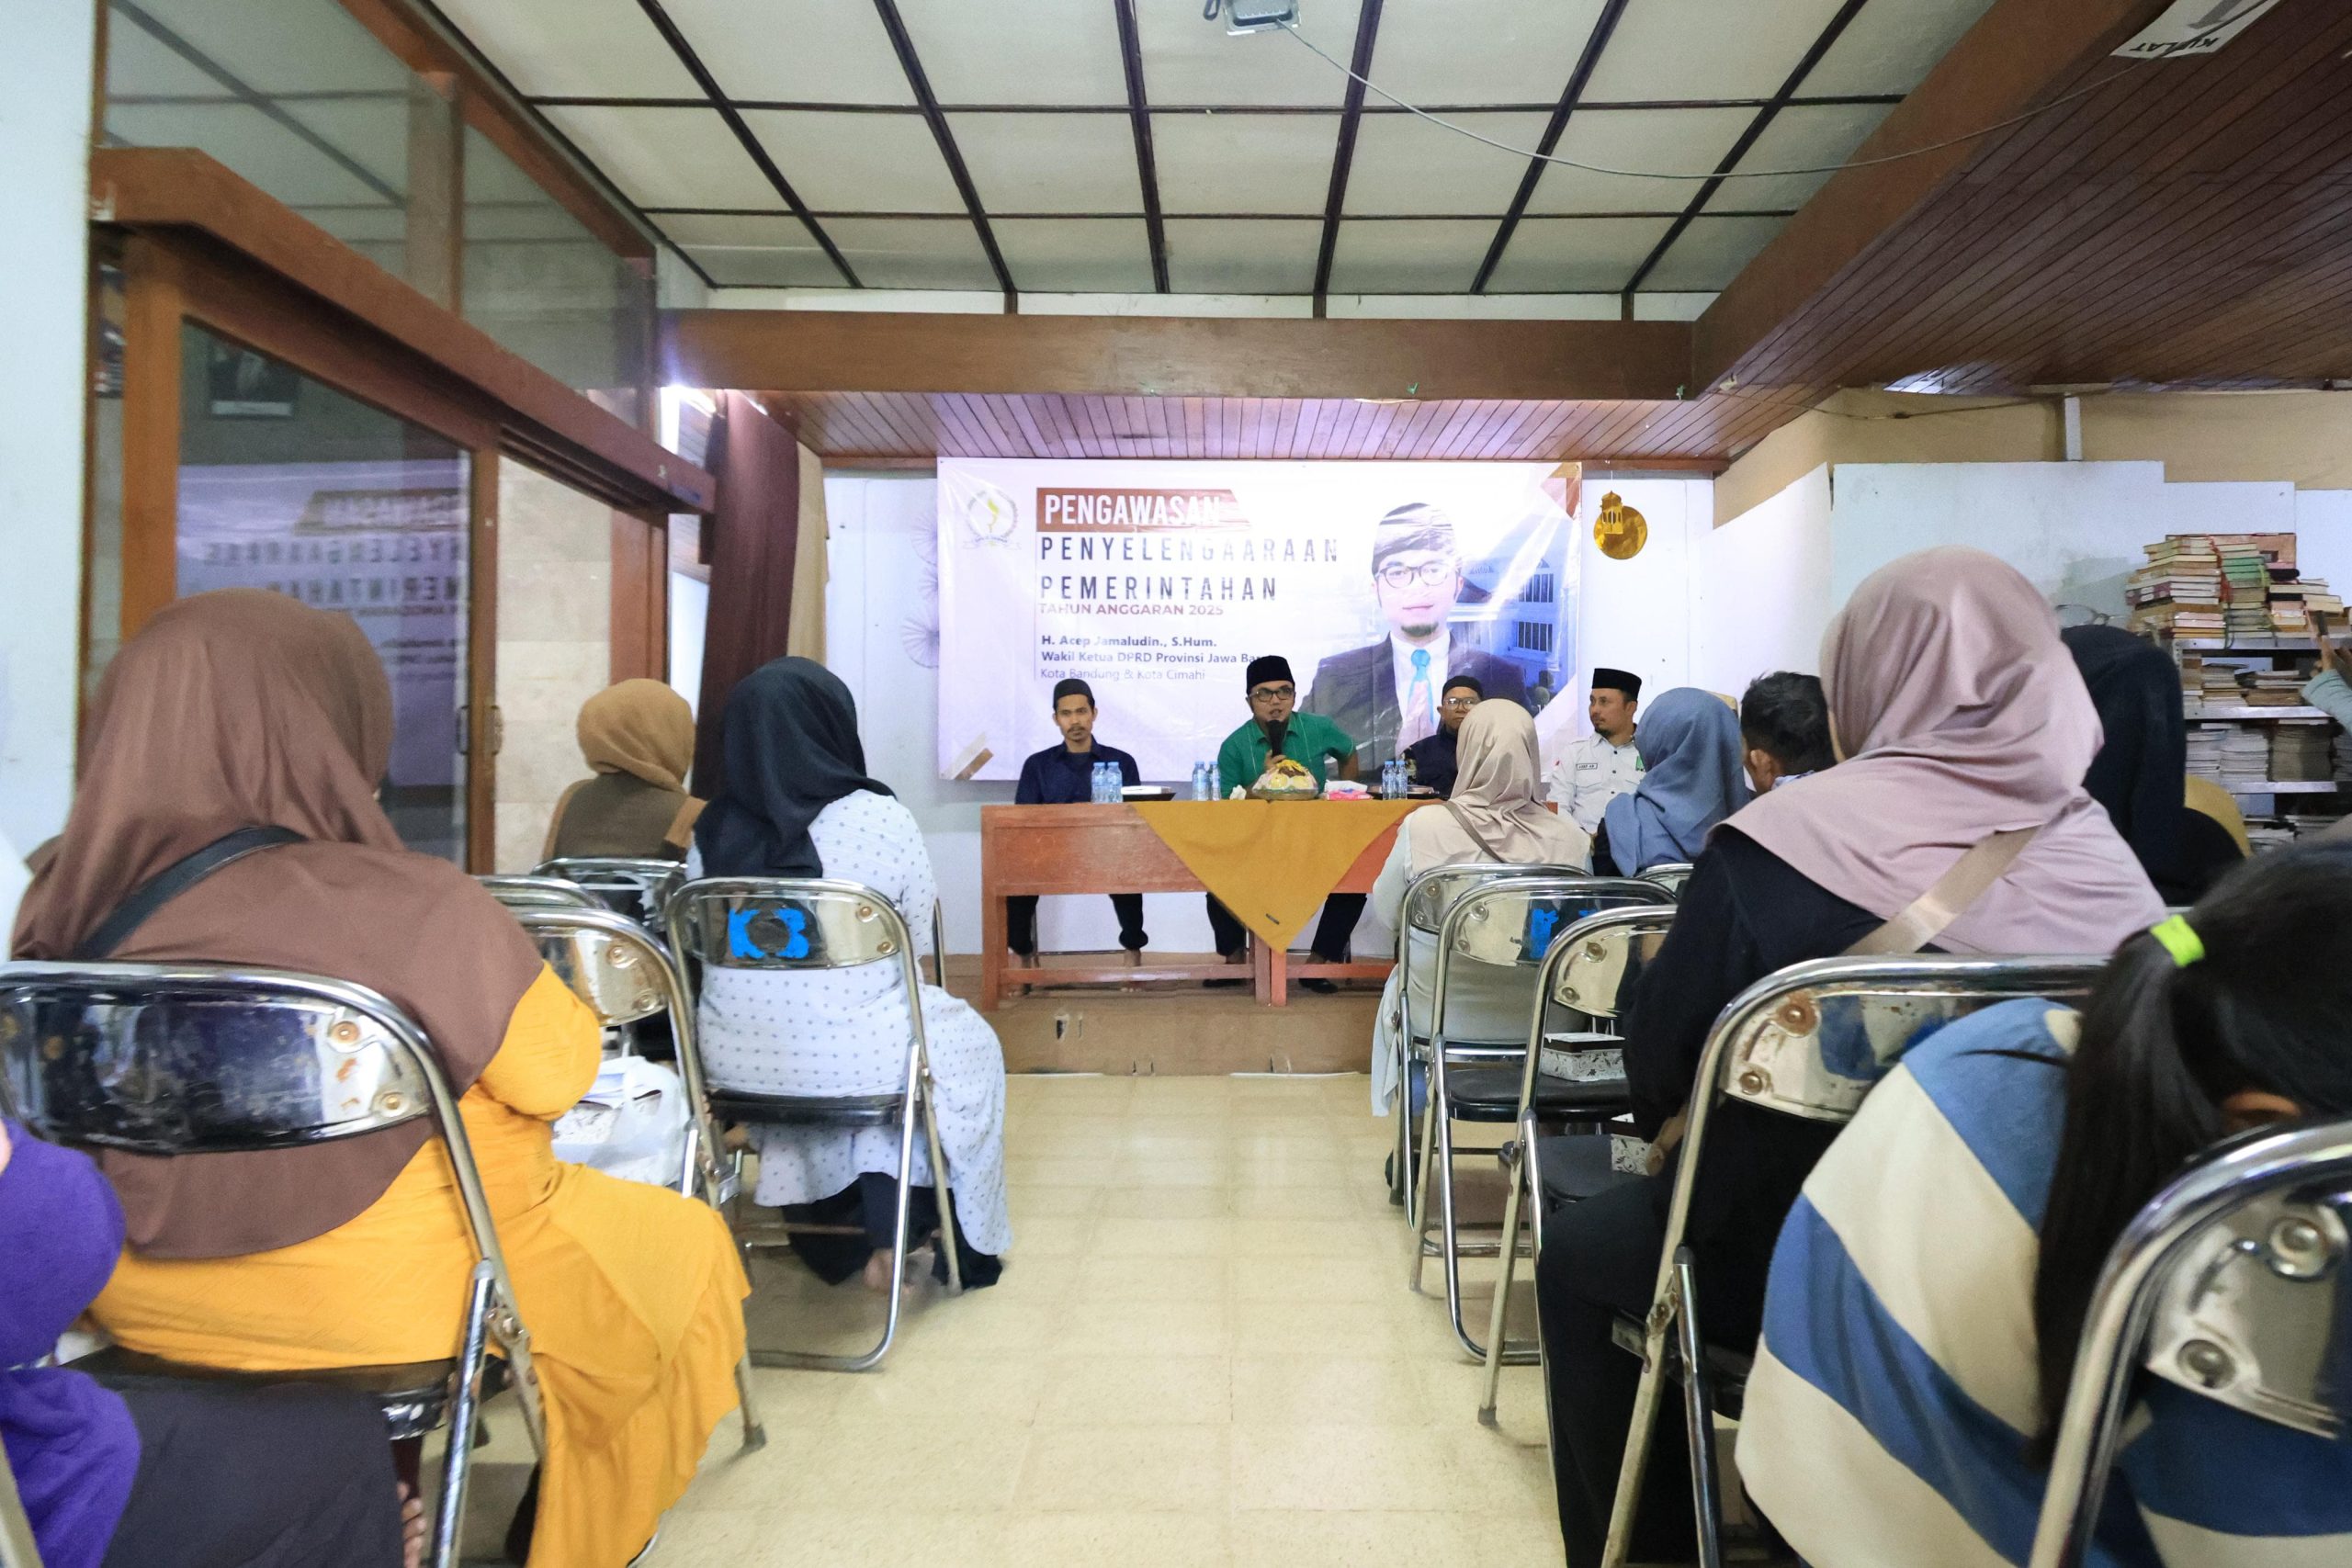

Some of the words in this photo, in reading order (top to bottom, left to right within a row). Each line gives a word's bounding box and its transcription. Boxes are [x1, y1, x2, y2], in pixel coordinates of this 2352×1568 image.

[1045, 494, 1220, 526] PENGAWASAN
[1041, 536, 1338, 562] PENYELENGAARAAN
[1041, 575, 1276, 601] PEMERINTAHAN
[1039, 604, 1091, 614] TAHUN
[1096, 604, 1184, 615] ANGGARAN
[1189, 604, 1224, 615] 2025
[1041, 635, 1056, 646] H.
[1059, 635, 1091, 648] Acep
[1171, 636, 1217, 647] S.Hum.
[1041, 650, 1075, 661] Wakil
[1079, 651, 1114, 662] Ketua
[1117, 652, 1152, 663] DPRD
[1156, 652, 1204, 663] Provinsi
[1207, 653, 1238, 663] Jawa
[1040, 668, 1066, 679] Kota
[1069, 669, 1120, 681] Bandung
[1124, 669, 1134, 680] &
[1136, 670, 1162, 680] Kota
[1166, 670, 1205, 680] Cimahi
